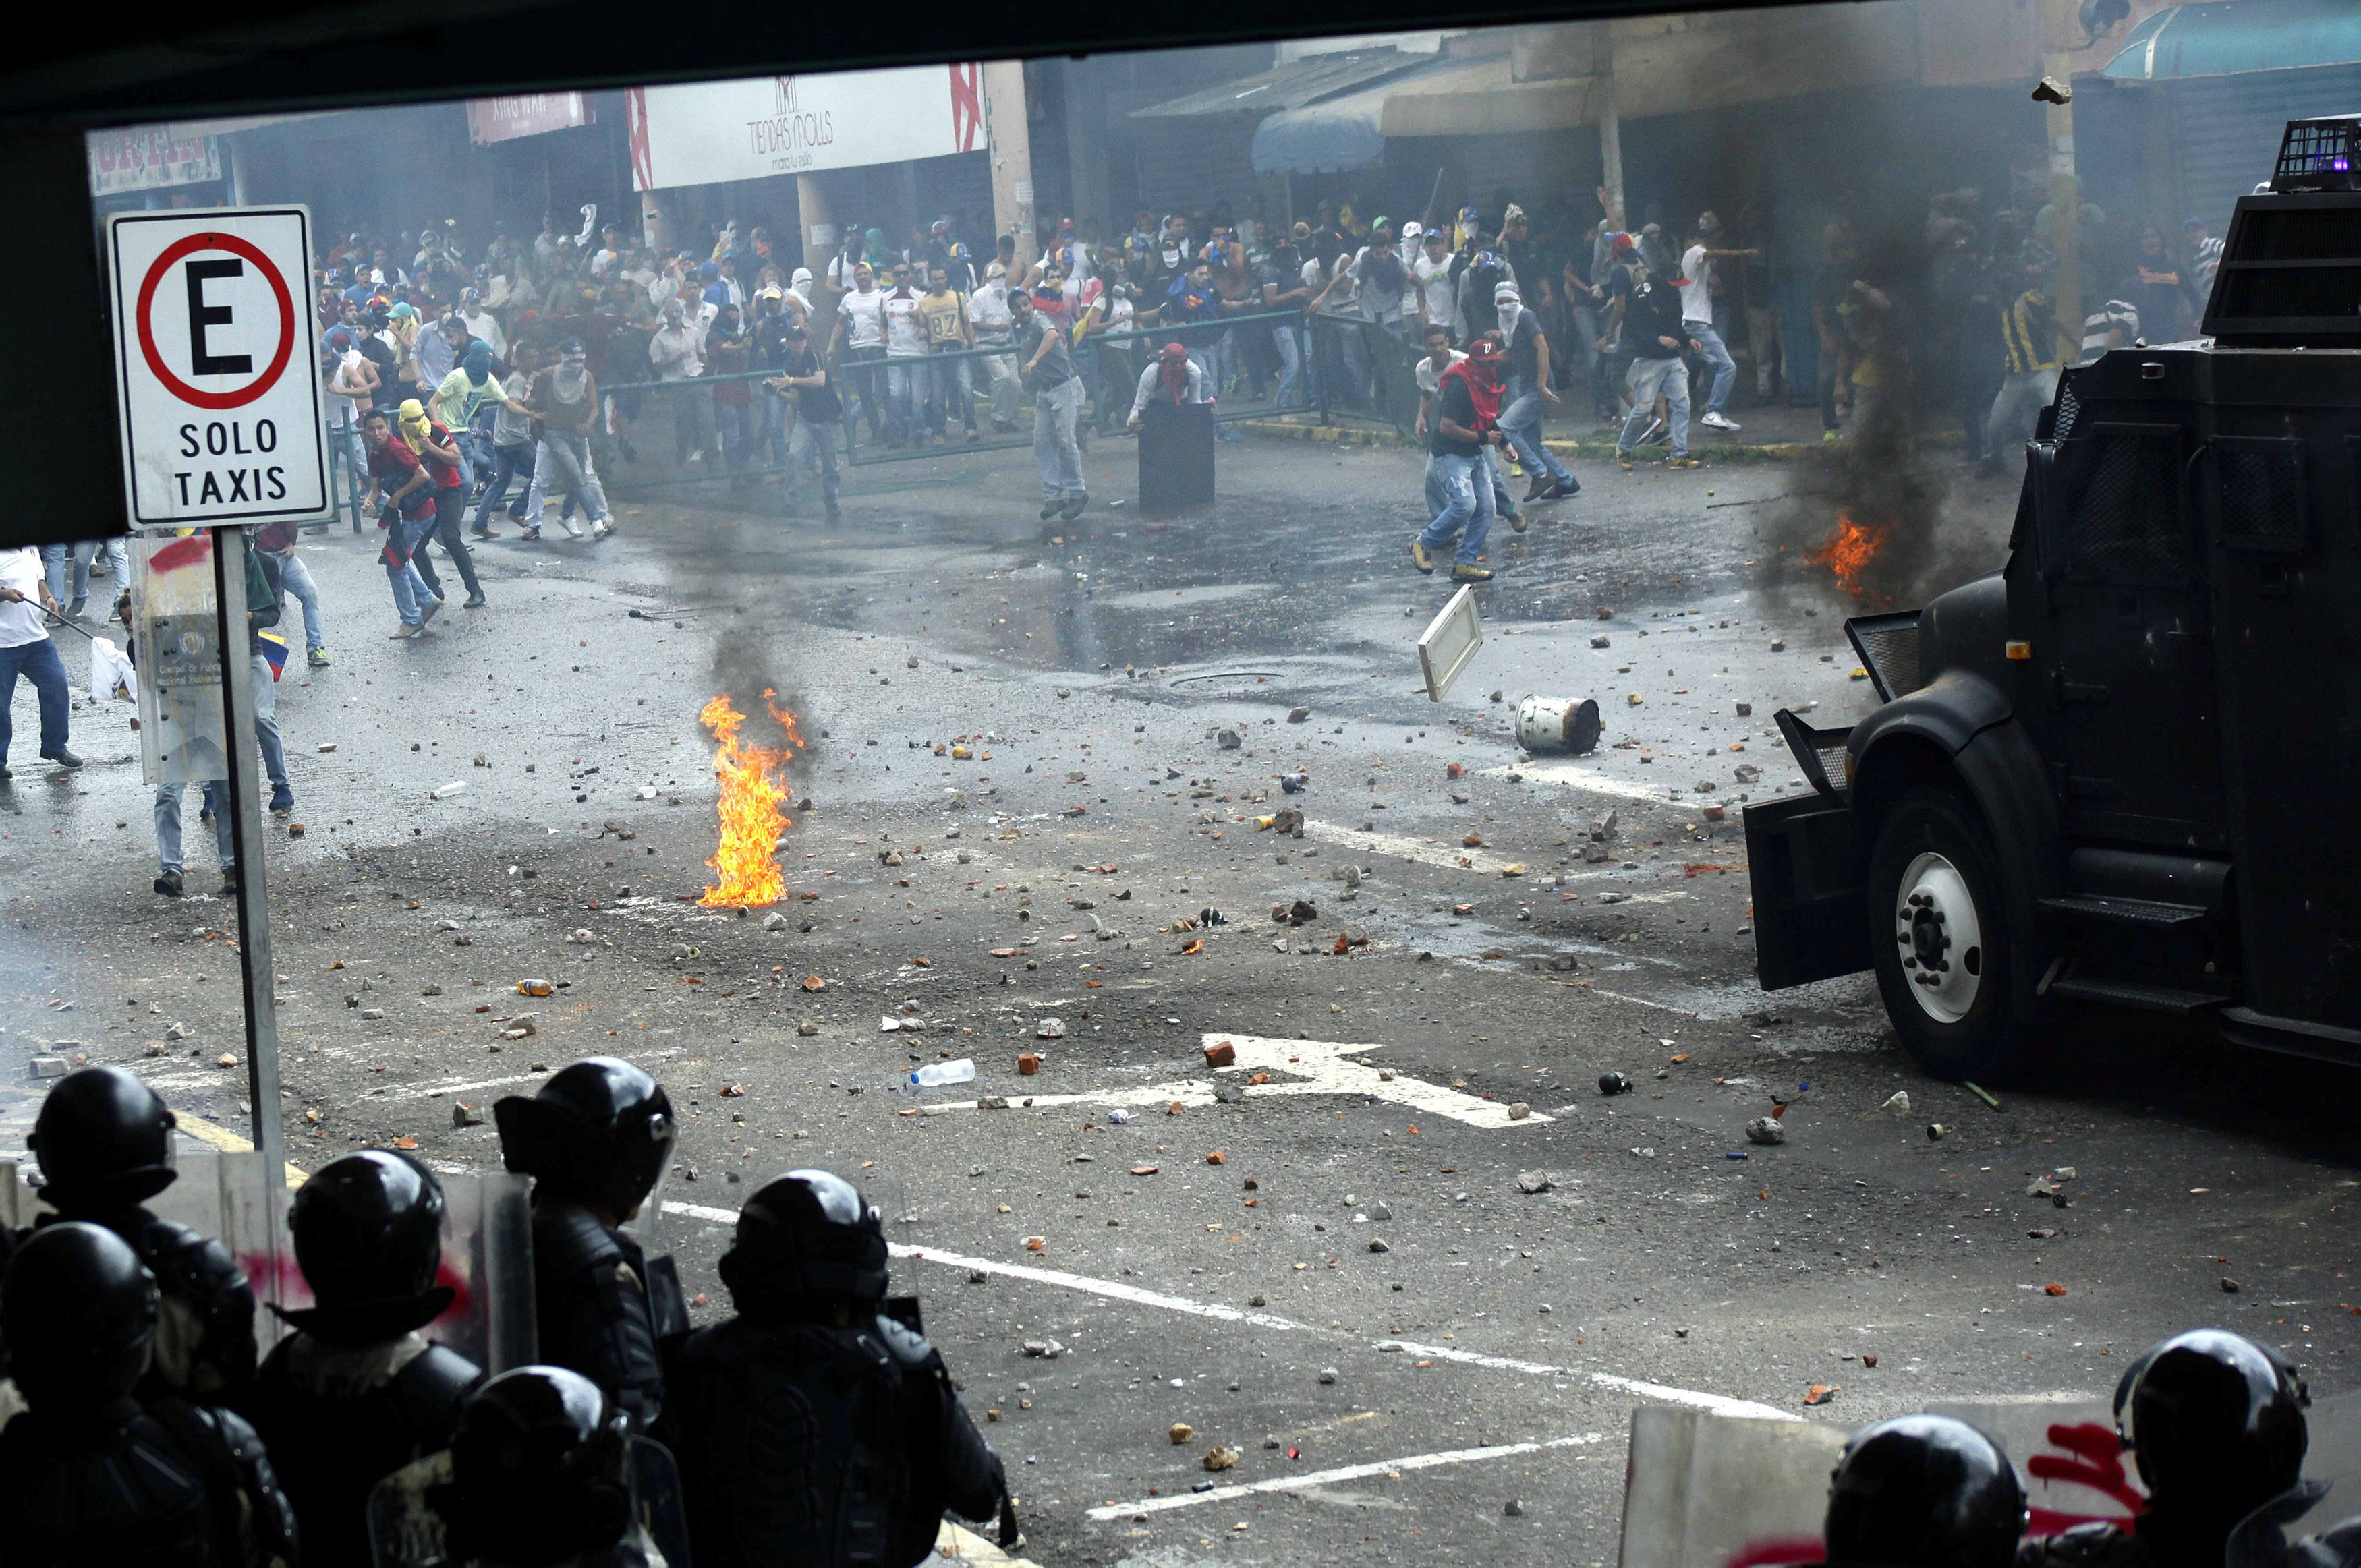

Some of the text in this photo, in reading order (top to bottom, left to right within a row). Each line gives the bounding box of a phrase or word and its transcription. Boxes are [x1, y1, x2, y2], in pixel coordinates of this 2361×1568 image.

[747, 111, 833, 154] TIENDAS MOLLS
[186, 258, 253, 375] E
[179, 419, 277, 457] SOLO
[174, 466, 286, 506] TAXIS
